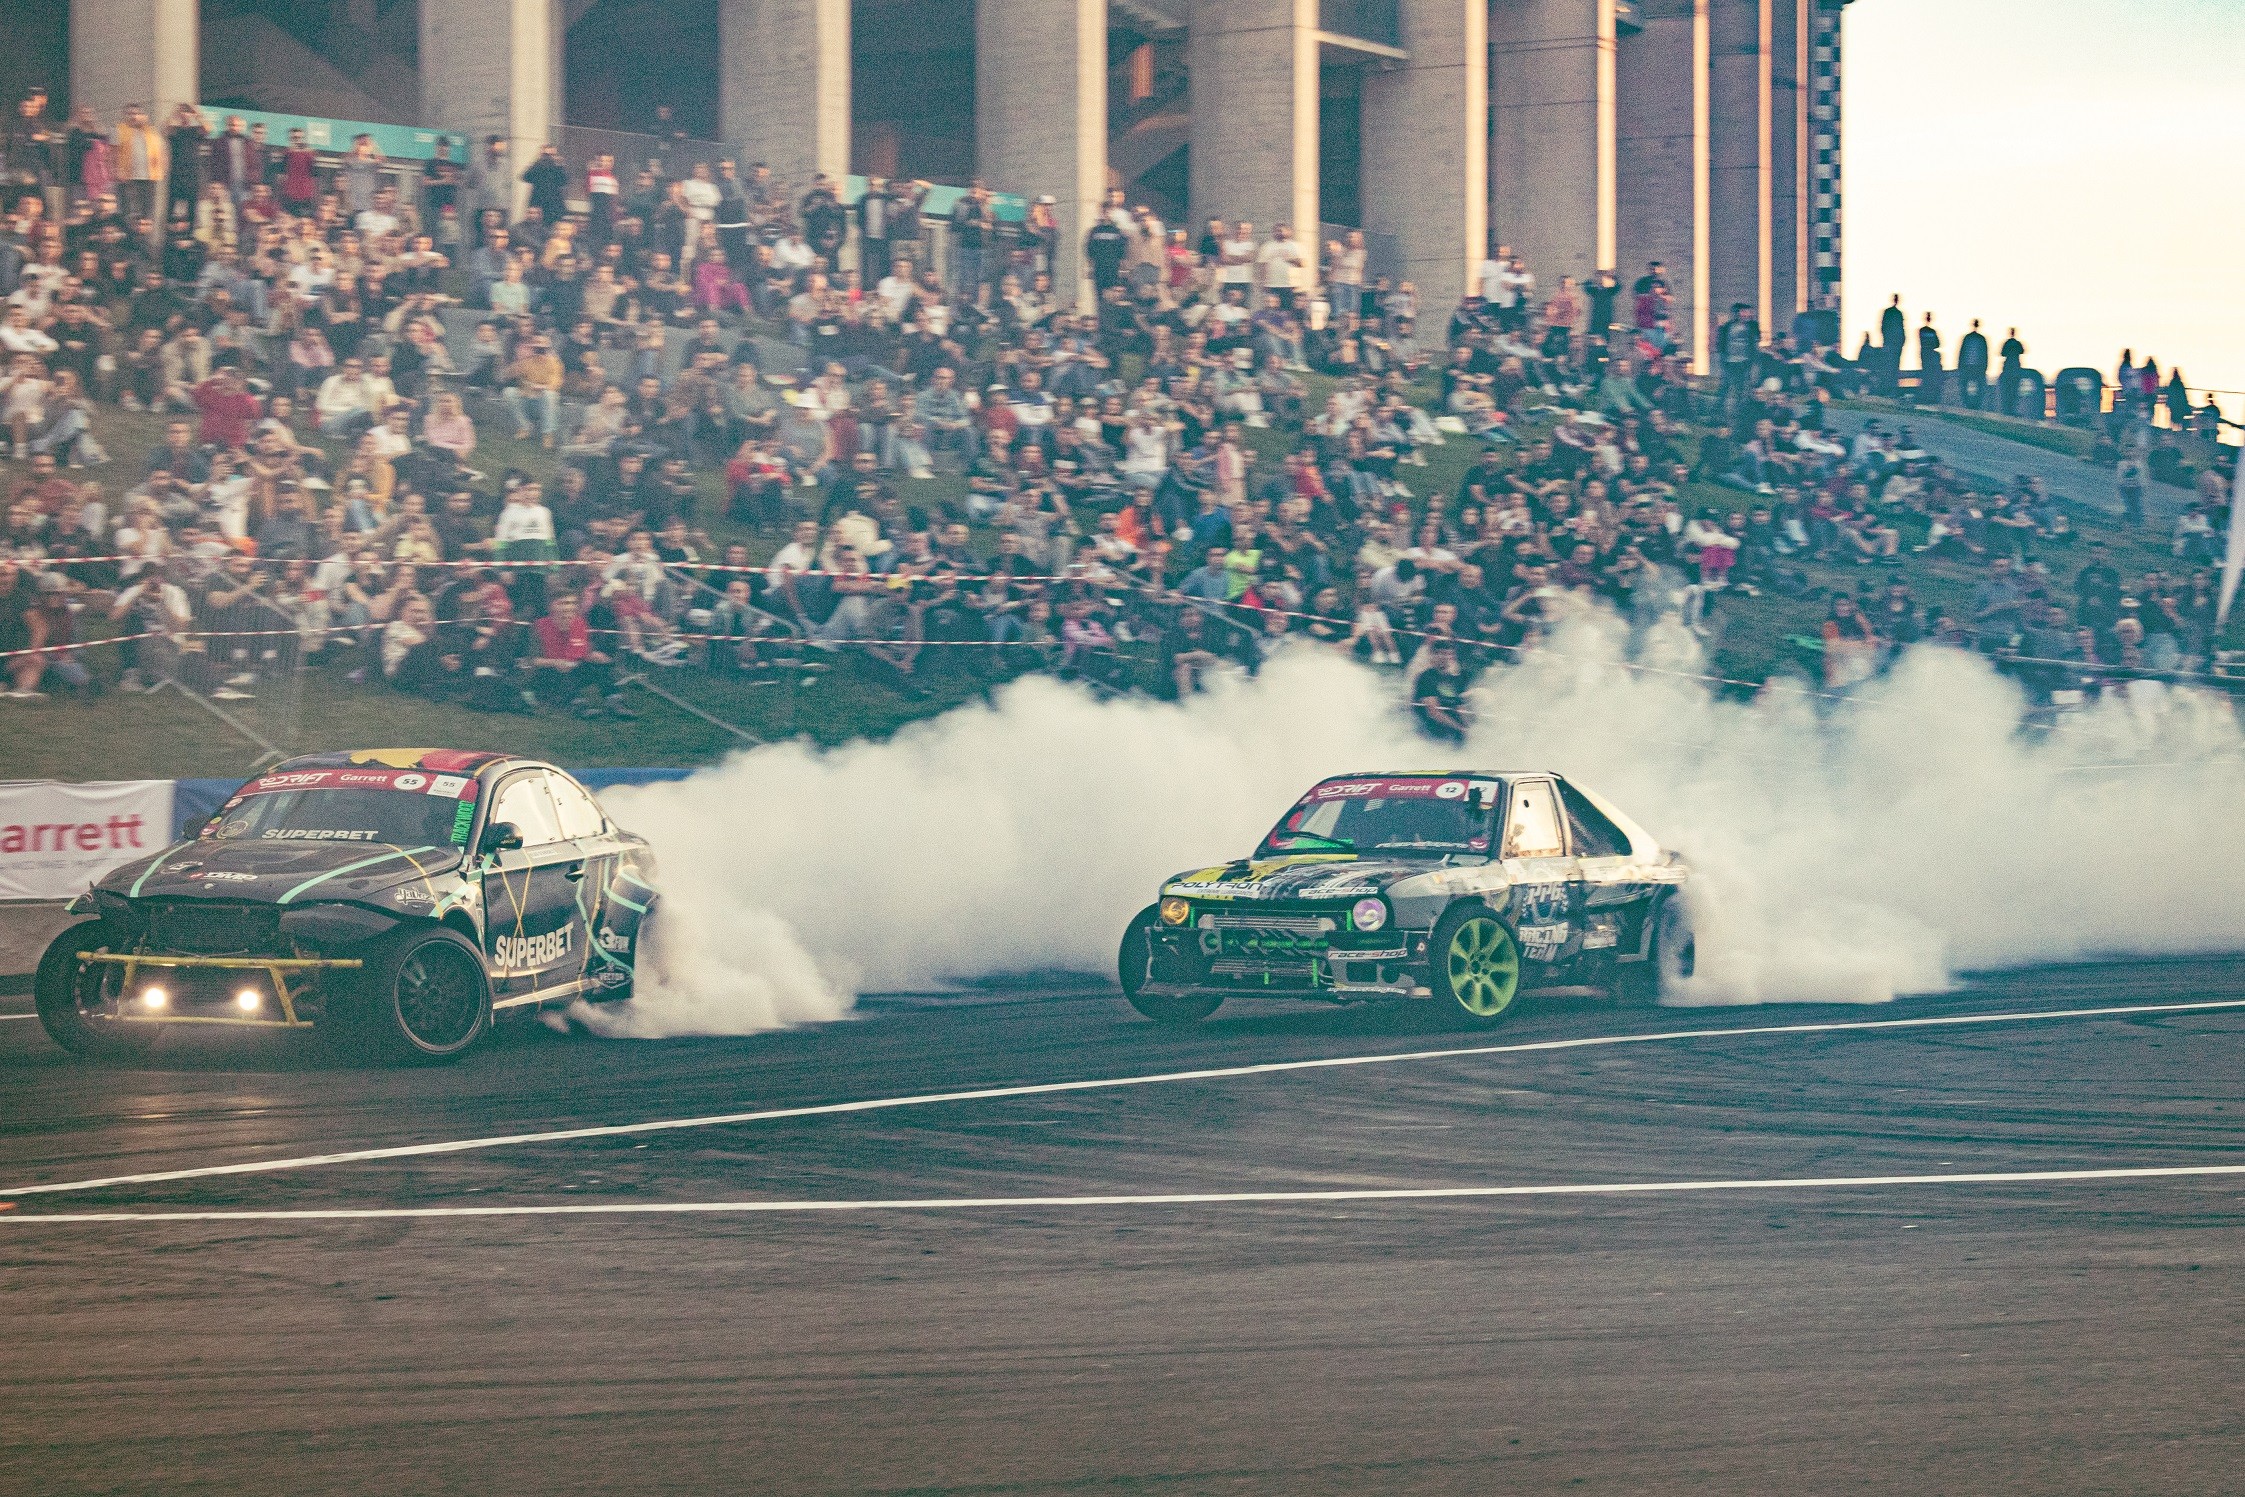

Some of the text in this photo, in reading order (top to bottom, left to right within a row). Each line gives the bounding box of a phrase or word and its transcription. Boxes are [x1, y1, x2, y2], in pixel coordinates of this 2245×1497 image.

[340, 774, 388, 783] Garrett
[401, 777, 418, 786] 55
[442, 780, 456, 788] 55
[1388, 784, 1432, 792] Garrett
[261, 829, 379, 841] SUPERBET
[1171, 882, 1263, 891] POLYTRON
[1301, 886, 1378, 896] race-shop
[494, 922, 574, 968] SUPERBET
[1329, 948, 1407, 959] race-shop
